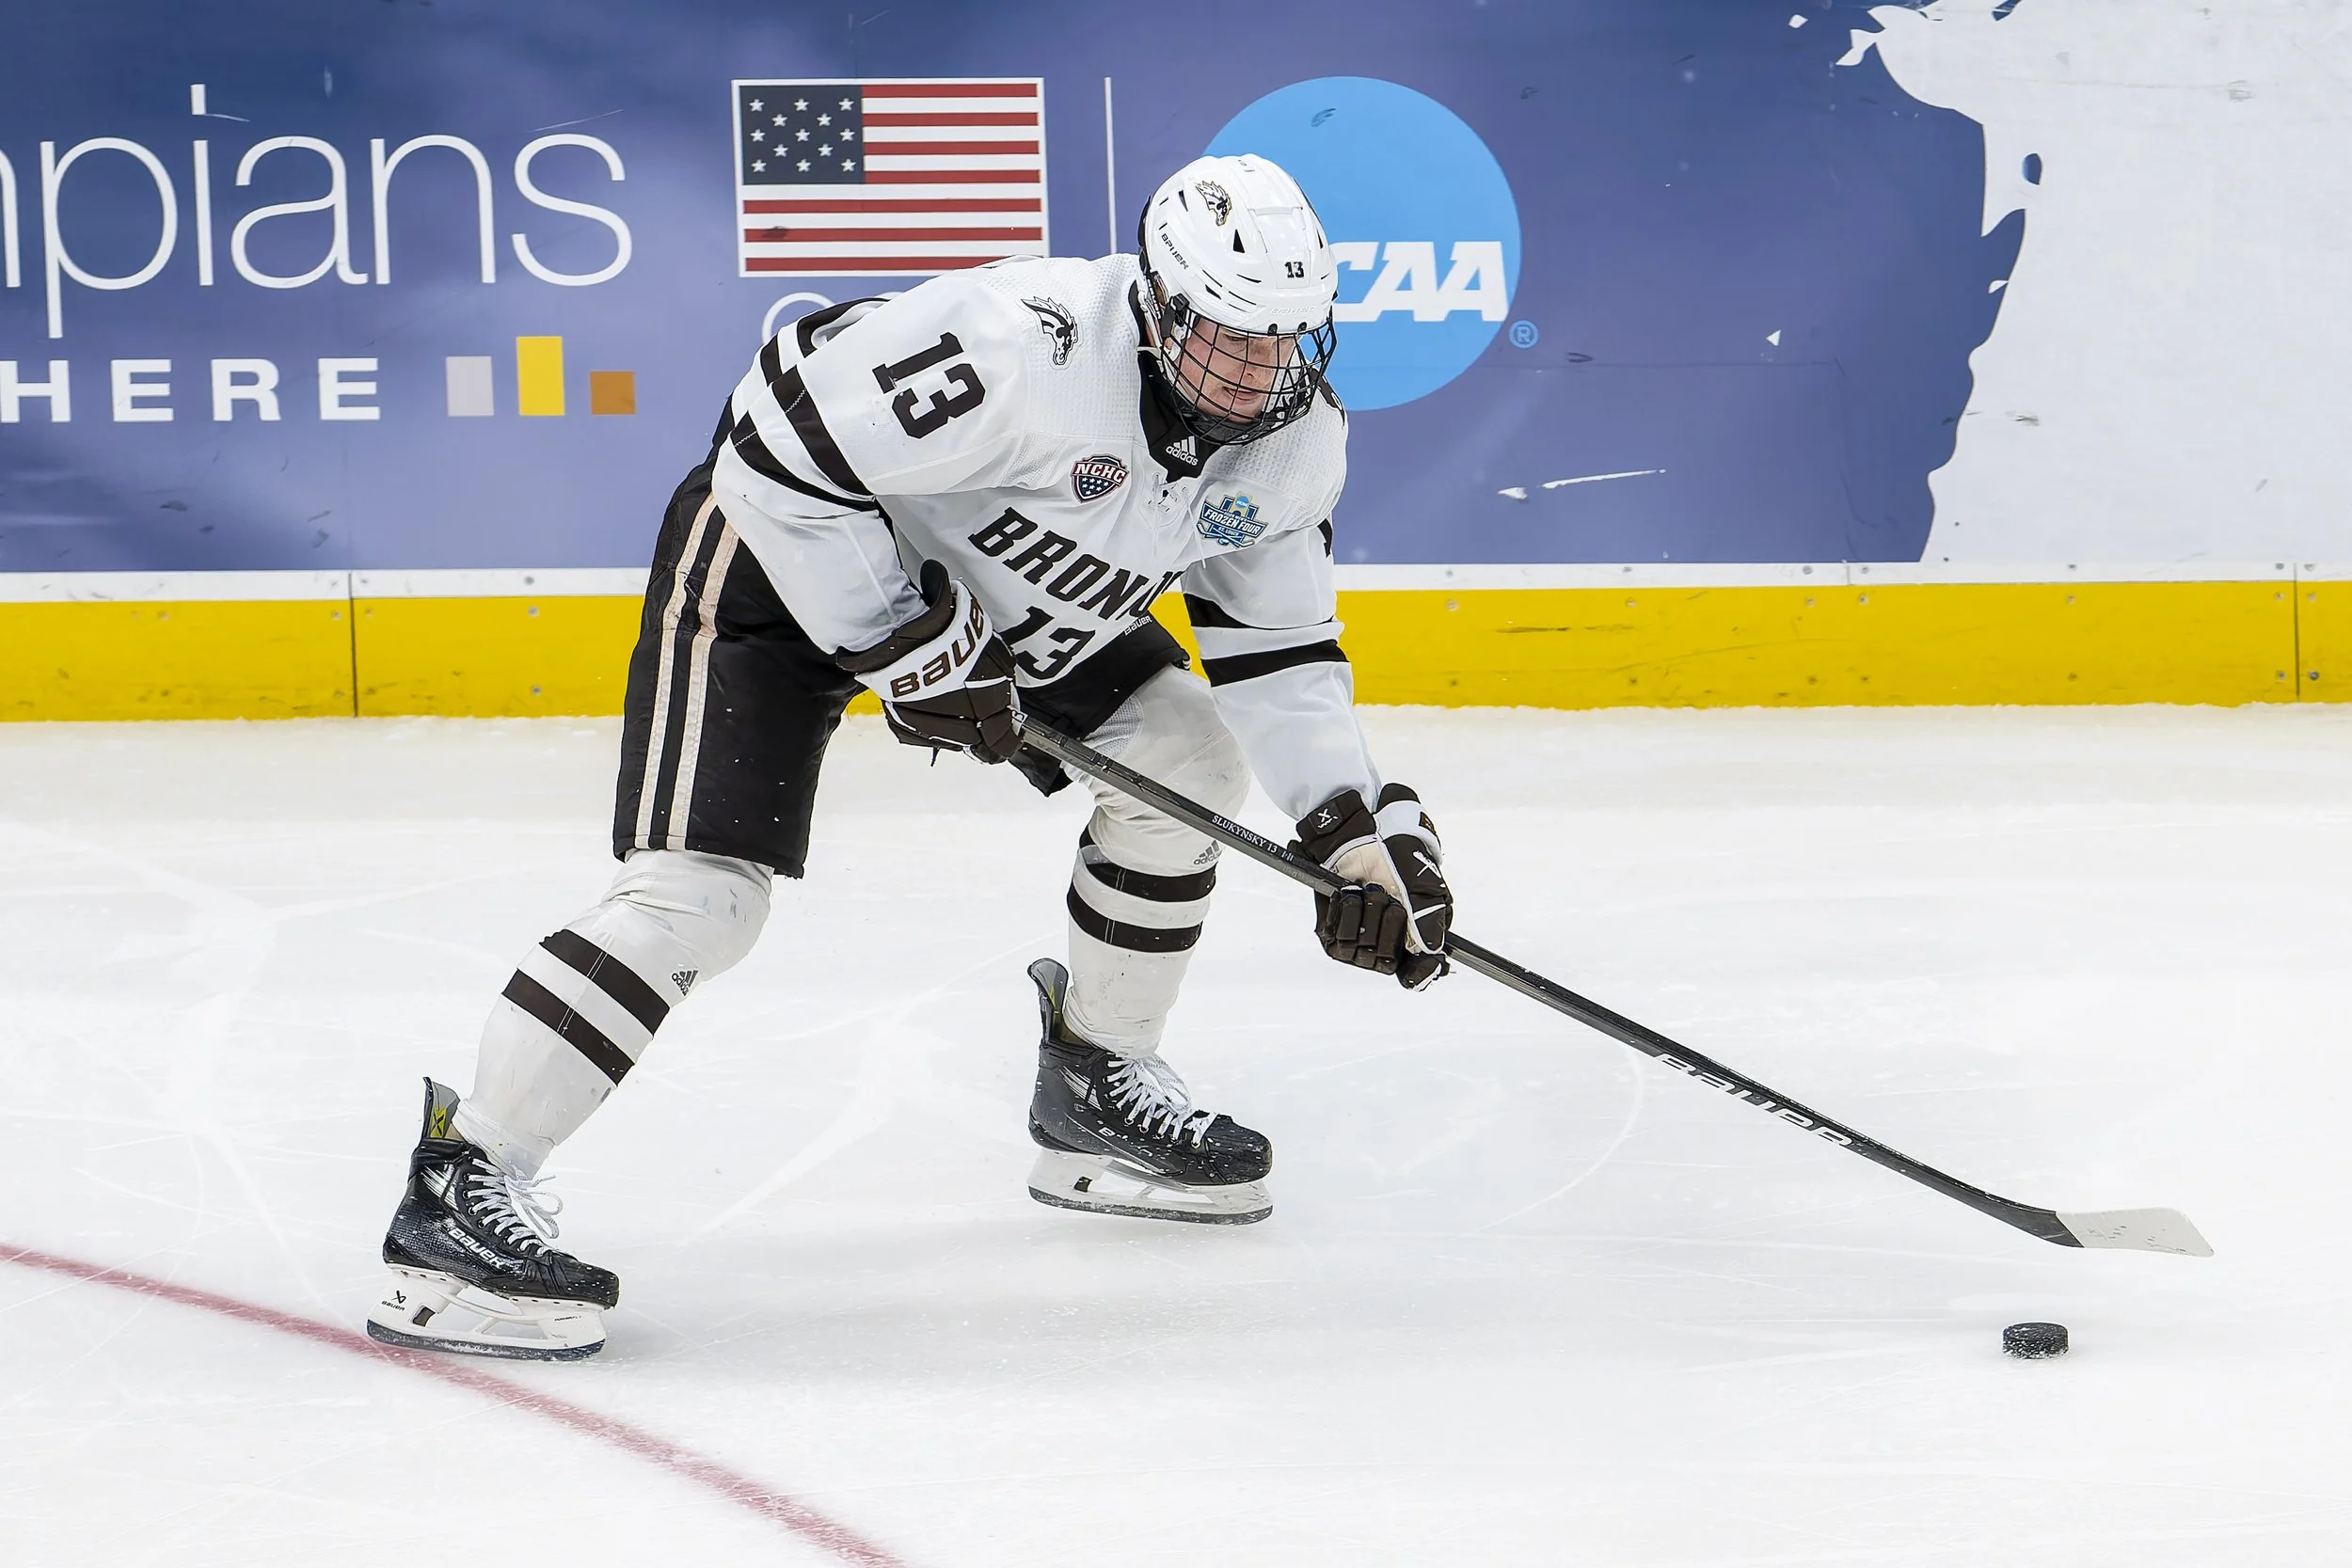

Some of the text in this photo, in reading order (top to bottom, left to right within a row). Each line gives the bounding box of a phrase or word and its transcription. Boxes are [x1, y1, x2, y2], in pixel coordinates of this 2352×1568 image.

[1284, 261, 1305, 279] 13
[1330, 240, 1509, 322] CAA
[0, 356, 381, 423] HERE
[872, 331, 987, 439] 13
[1074, 462, 1127, 484] NCHC
[1166, 445, 1199, 467] adidas
[1203, 508, 1240, 530] FROZEN
[1237, 520, 1262, 535] FOUR
[889, 597, 985, 698] BAUE
[997, 606, 1096, 680] 13
[1212, 815, 1279, 853] SLUKYNSKY 13
[448, 1227, 505, 1269] BAUER
